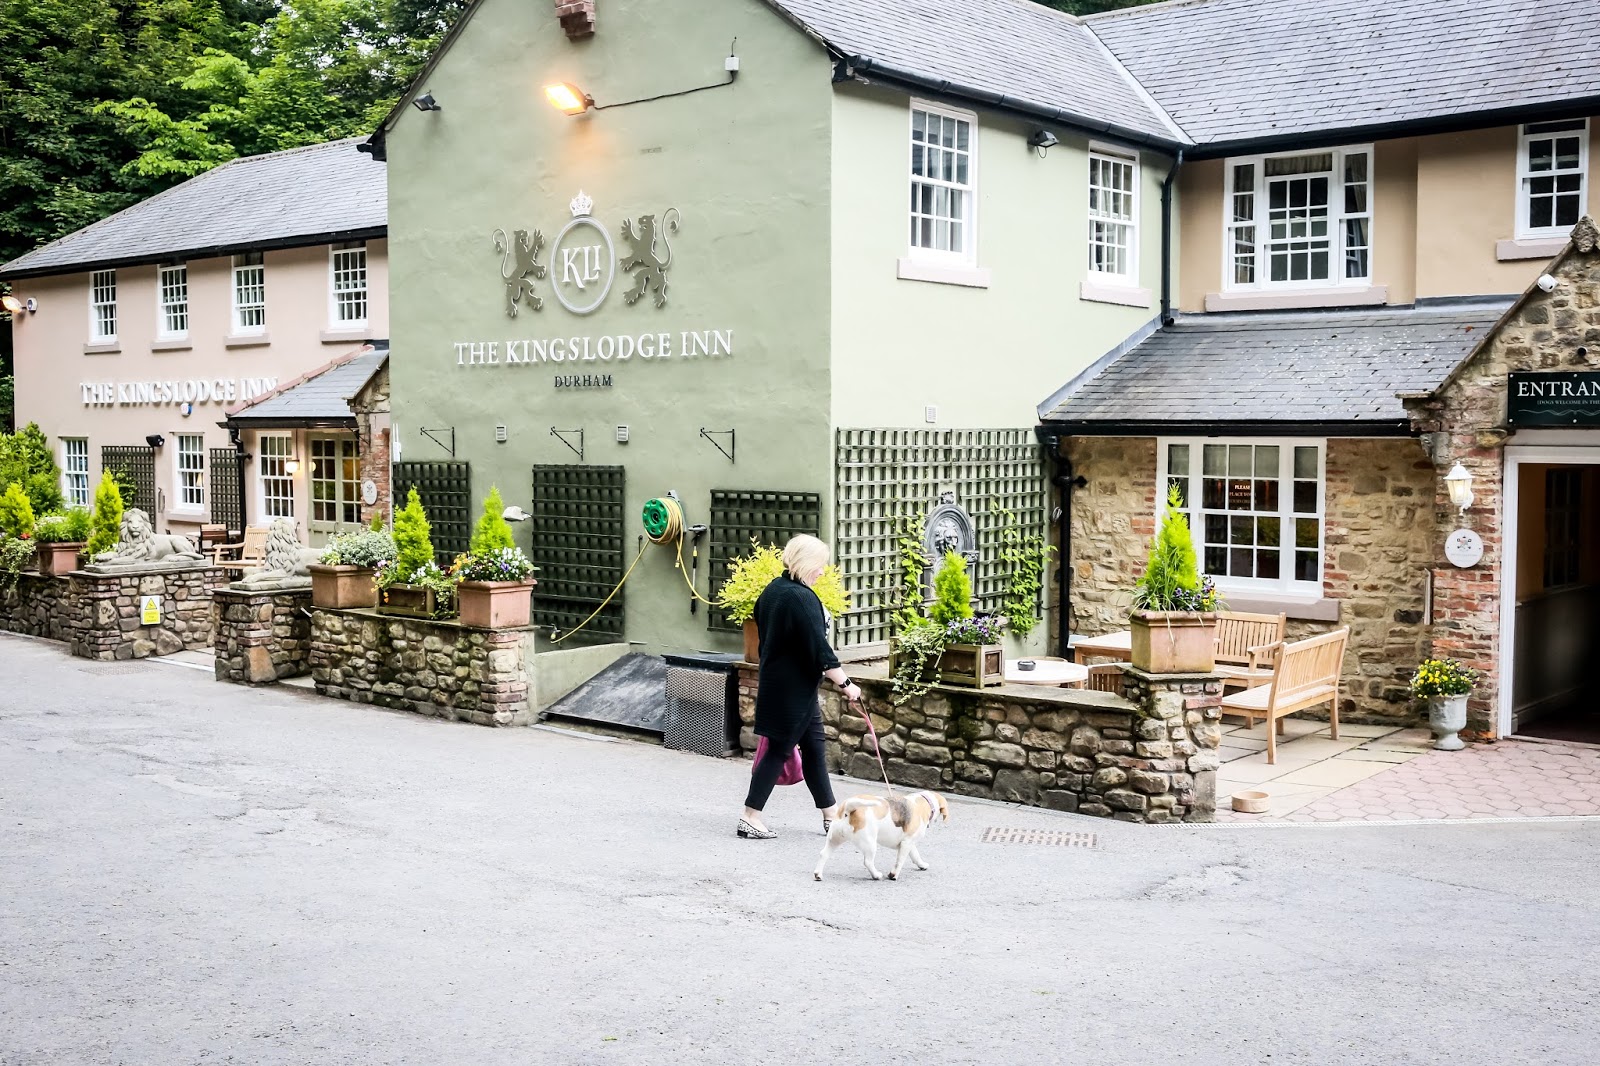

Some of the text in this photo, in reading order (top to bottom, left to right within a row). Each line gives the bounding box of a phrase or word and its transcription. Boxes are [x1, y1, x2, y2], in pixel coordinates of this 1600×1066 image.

[561, 244, 602, 289] KLI
[454, 329, 734, 366] THE KINGSLODGE INN
[80, 377, 278, 404] THE KINGSLODGE INN
[554, 374, 613, 388] DURHAM
